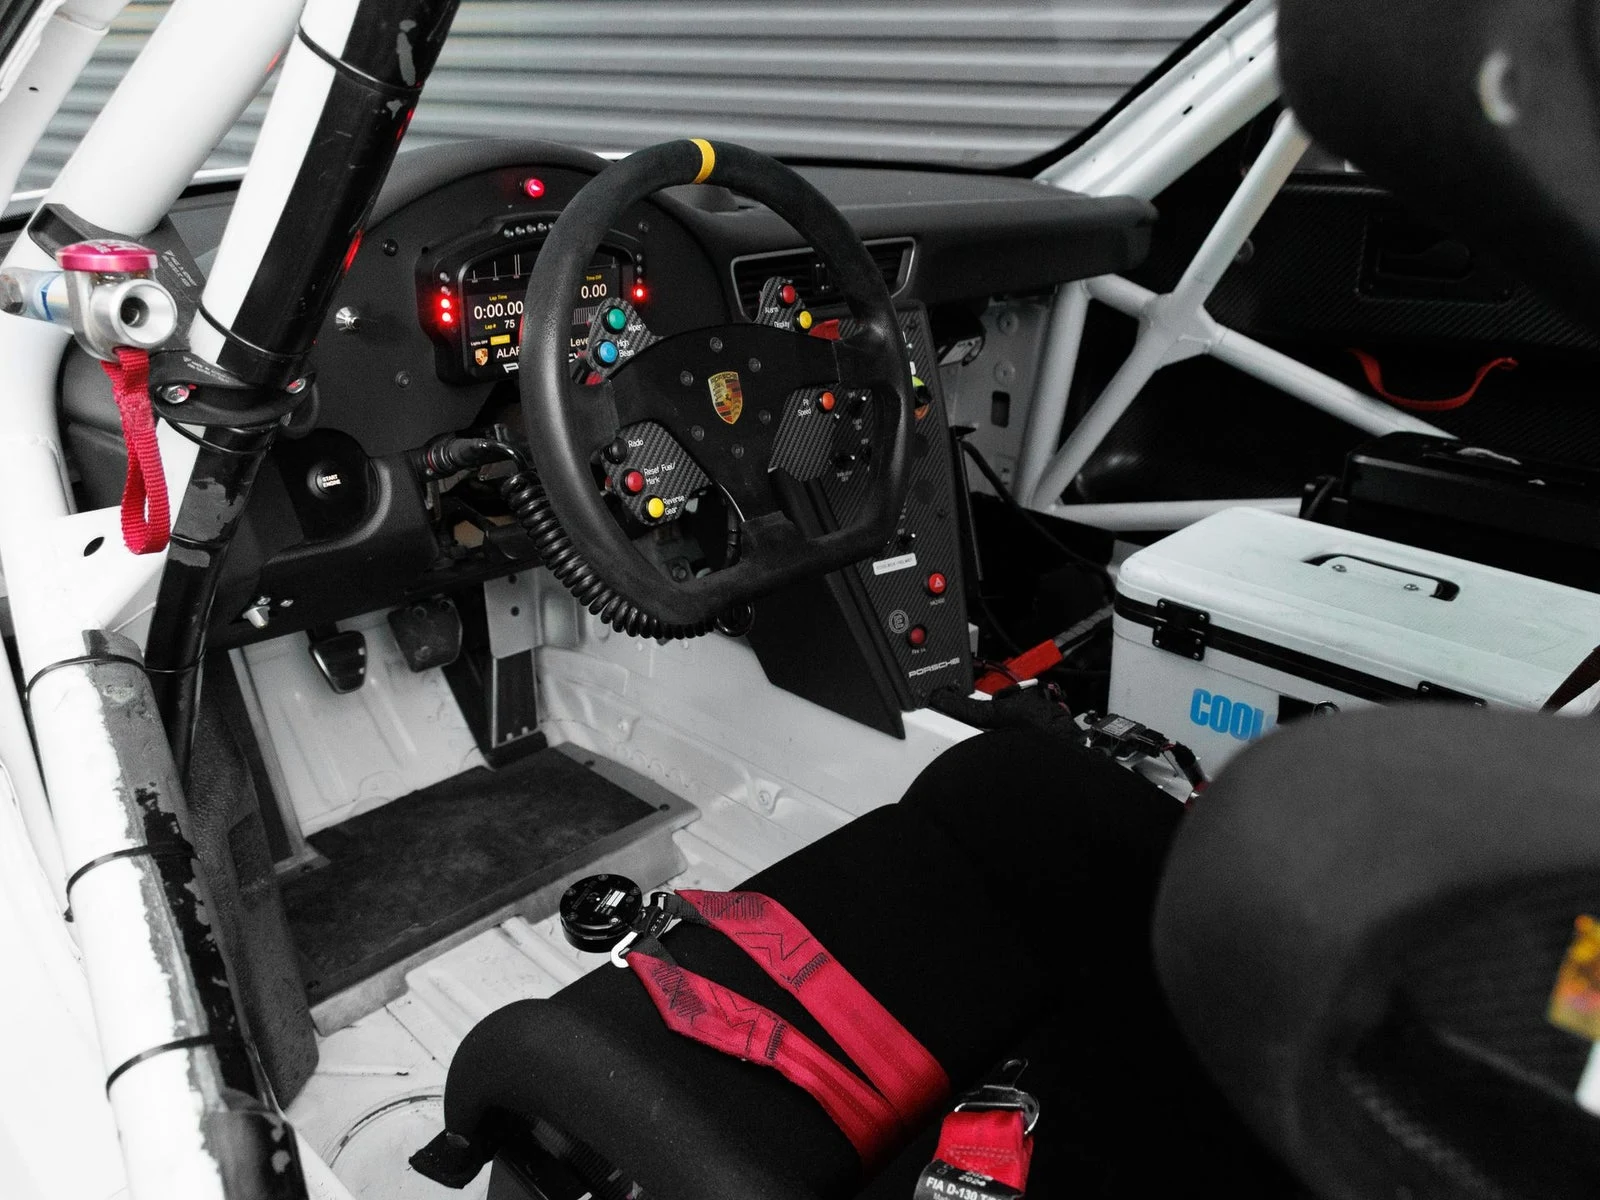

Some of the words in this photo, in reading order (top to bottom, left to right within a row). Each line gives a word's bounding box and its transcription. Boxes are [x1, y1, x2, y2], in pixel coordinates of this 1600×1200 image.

[581, 283, 607, 299] 0.00
[474, 301, 524, 320] 0:00.00
[504, 319, 516, 329] 75
[628, 439, 644, 448] Radio
[665, 507, 678, 516] Gear
[908, 657, 961, 678] PORSCHE
[925, 1176, 944, 1192] FIA
[946, 1183, 978, 1200] D-130
